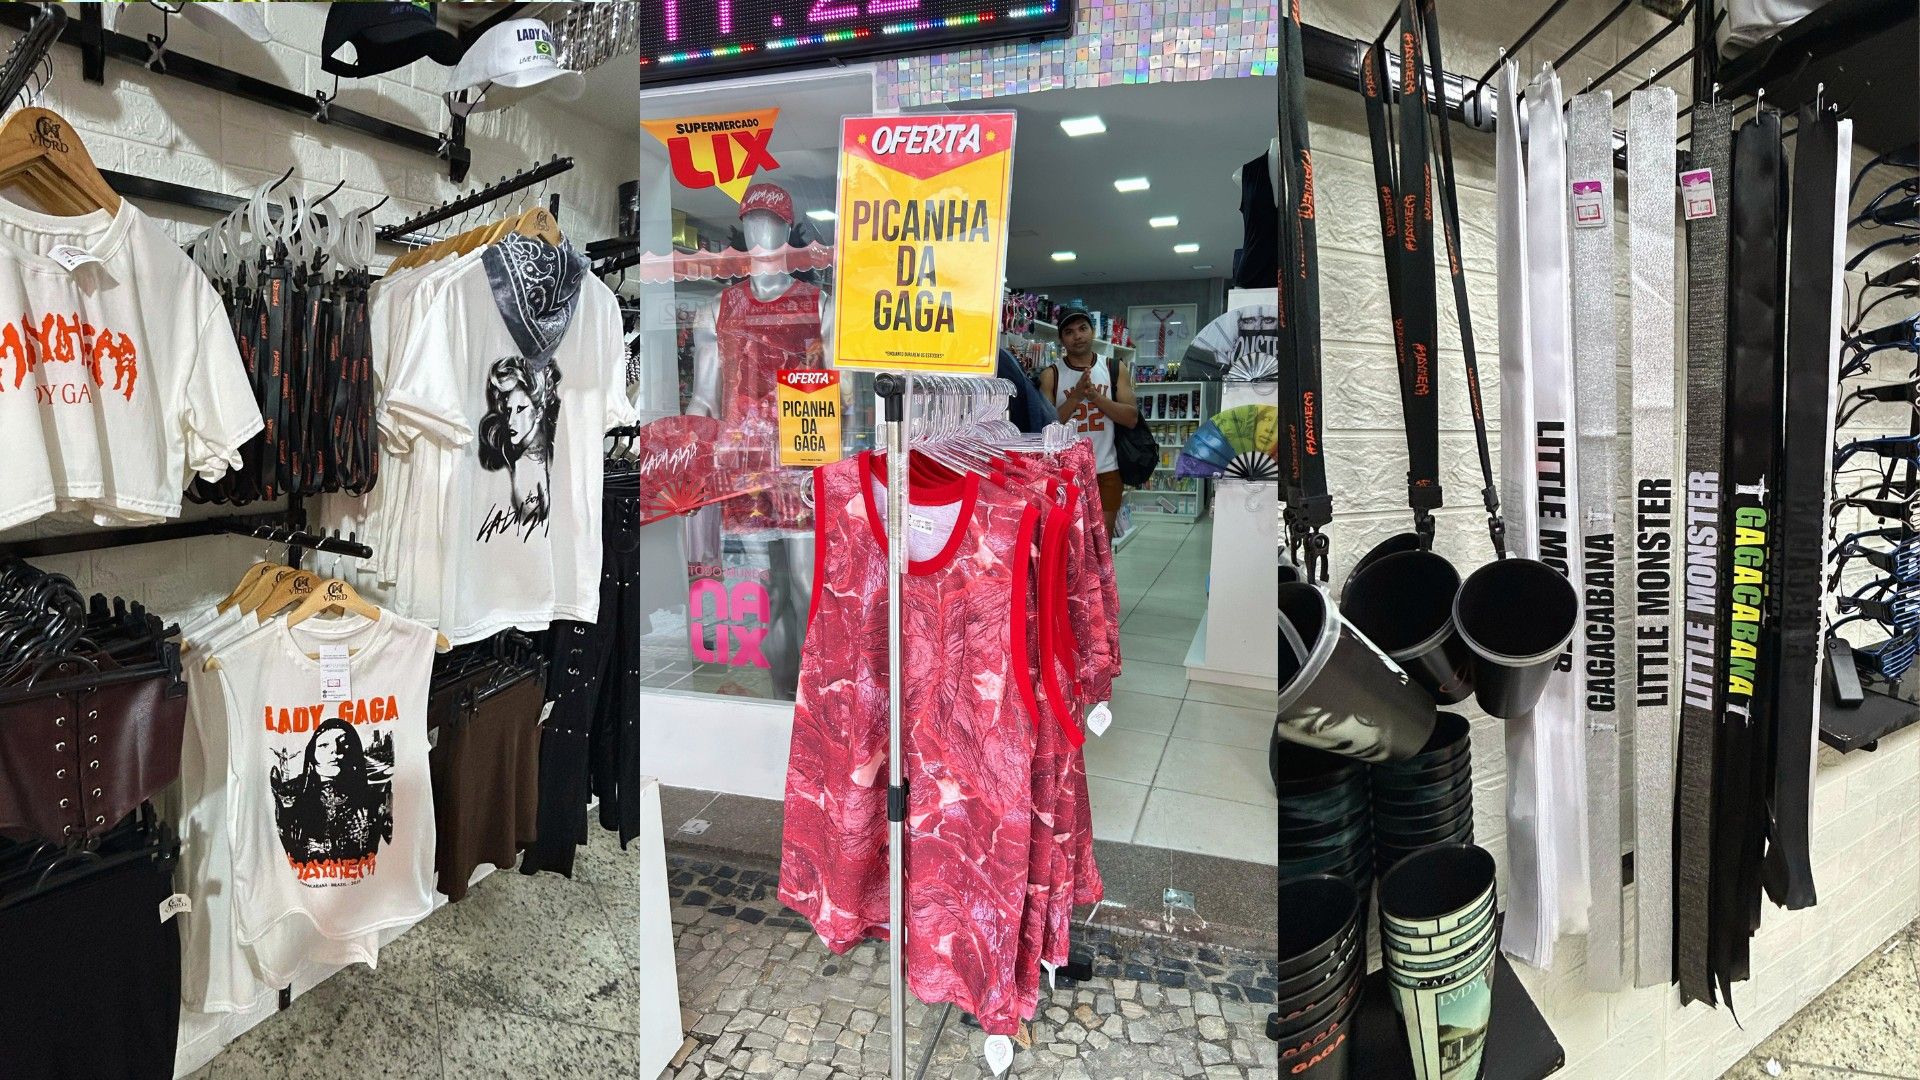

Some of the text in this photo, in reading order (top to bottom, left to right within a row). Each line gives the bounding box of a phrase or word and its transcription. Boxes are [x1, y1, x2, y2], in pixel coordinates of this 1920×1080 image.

[517, 28, 540, 41] LADY
[1403, 32, 1416, 95] MAYHEM
[675, 118, 759, 135] SUPERMERCADO
[871, 123, 982, 156] OFERTA
[667, 128, 781, 190] LIX
[852, 199, 990, 243] PICANHA
[1381, 185, 1397, 237] MAYHEM
[1404, 193, 1417, 252] MAYHEM
[896, 245, 937, 288] DA
[873, 289, 955, 333] GAGA
[787, 372, 830, 384] OFERTA
[1412, 343, 1430, 397] MAYHEM
[782, 401, 836, 418] PICANHA
[801, 418, 818, 435] DA
[1073, 402, 1105, 432] 22
[1303, 391, 1317, 456] MAYHEM
[794, 434, 826, 452] GAGA
[1537, 421, 1566, 519] LITTLE
[323, 593, 348, 602] VIORD
[1637, 478, 1672, 708] LITTLE MONSTER
[1685, 471, 1720, 711] LITTLE MONSTER
[1728, 506, 1767, 697] GAGACABANA
[1585, 533, 1616, 712] GAGACABANA
[265, 695, 399, 735] LADY GAGA
[288, 852, 376, 881] MAYHEM
[1291, 1034, 1345, 1074] GAGA
